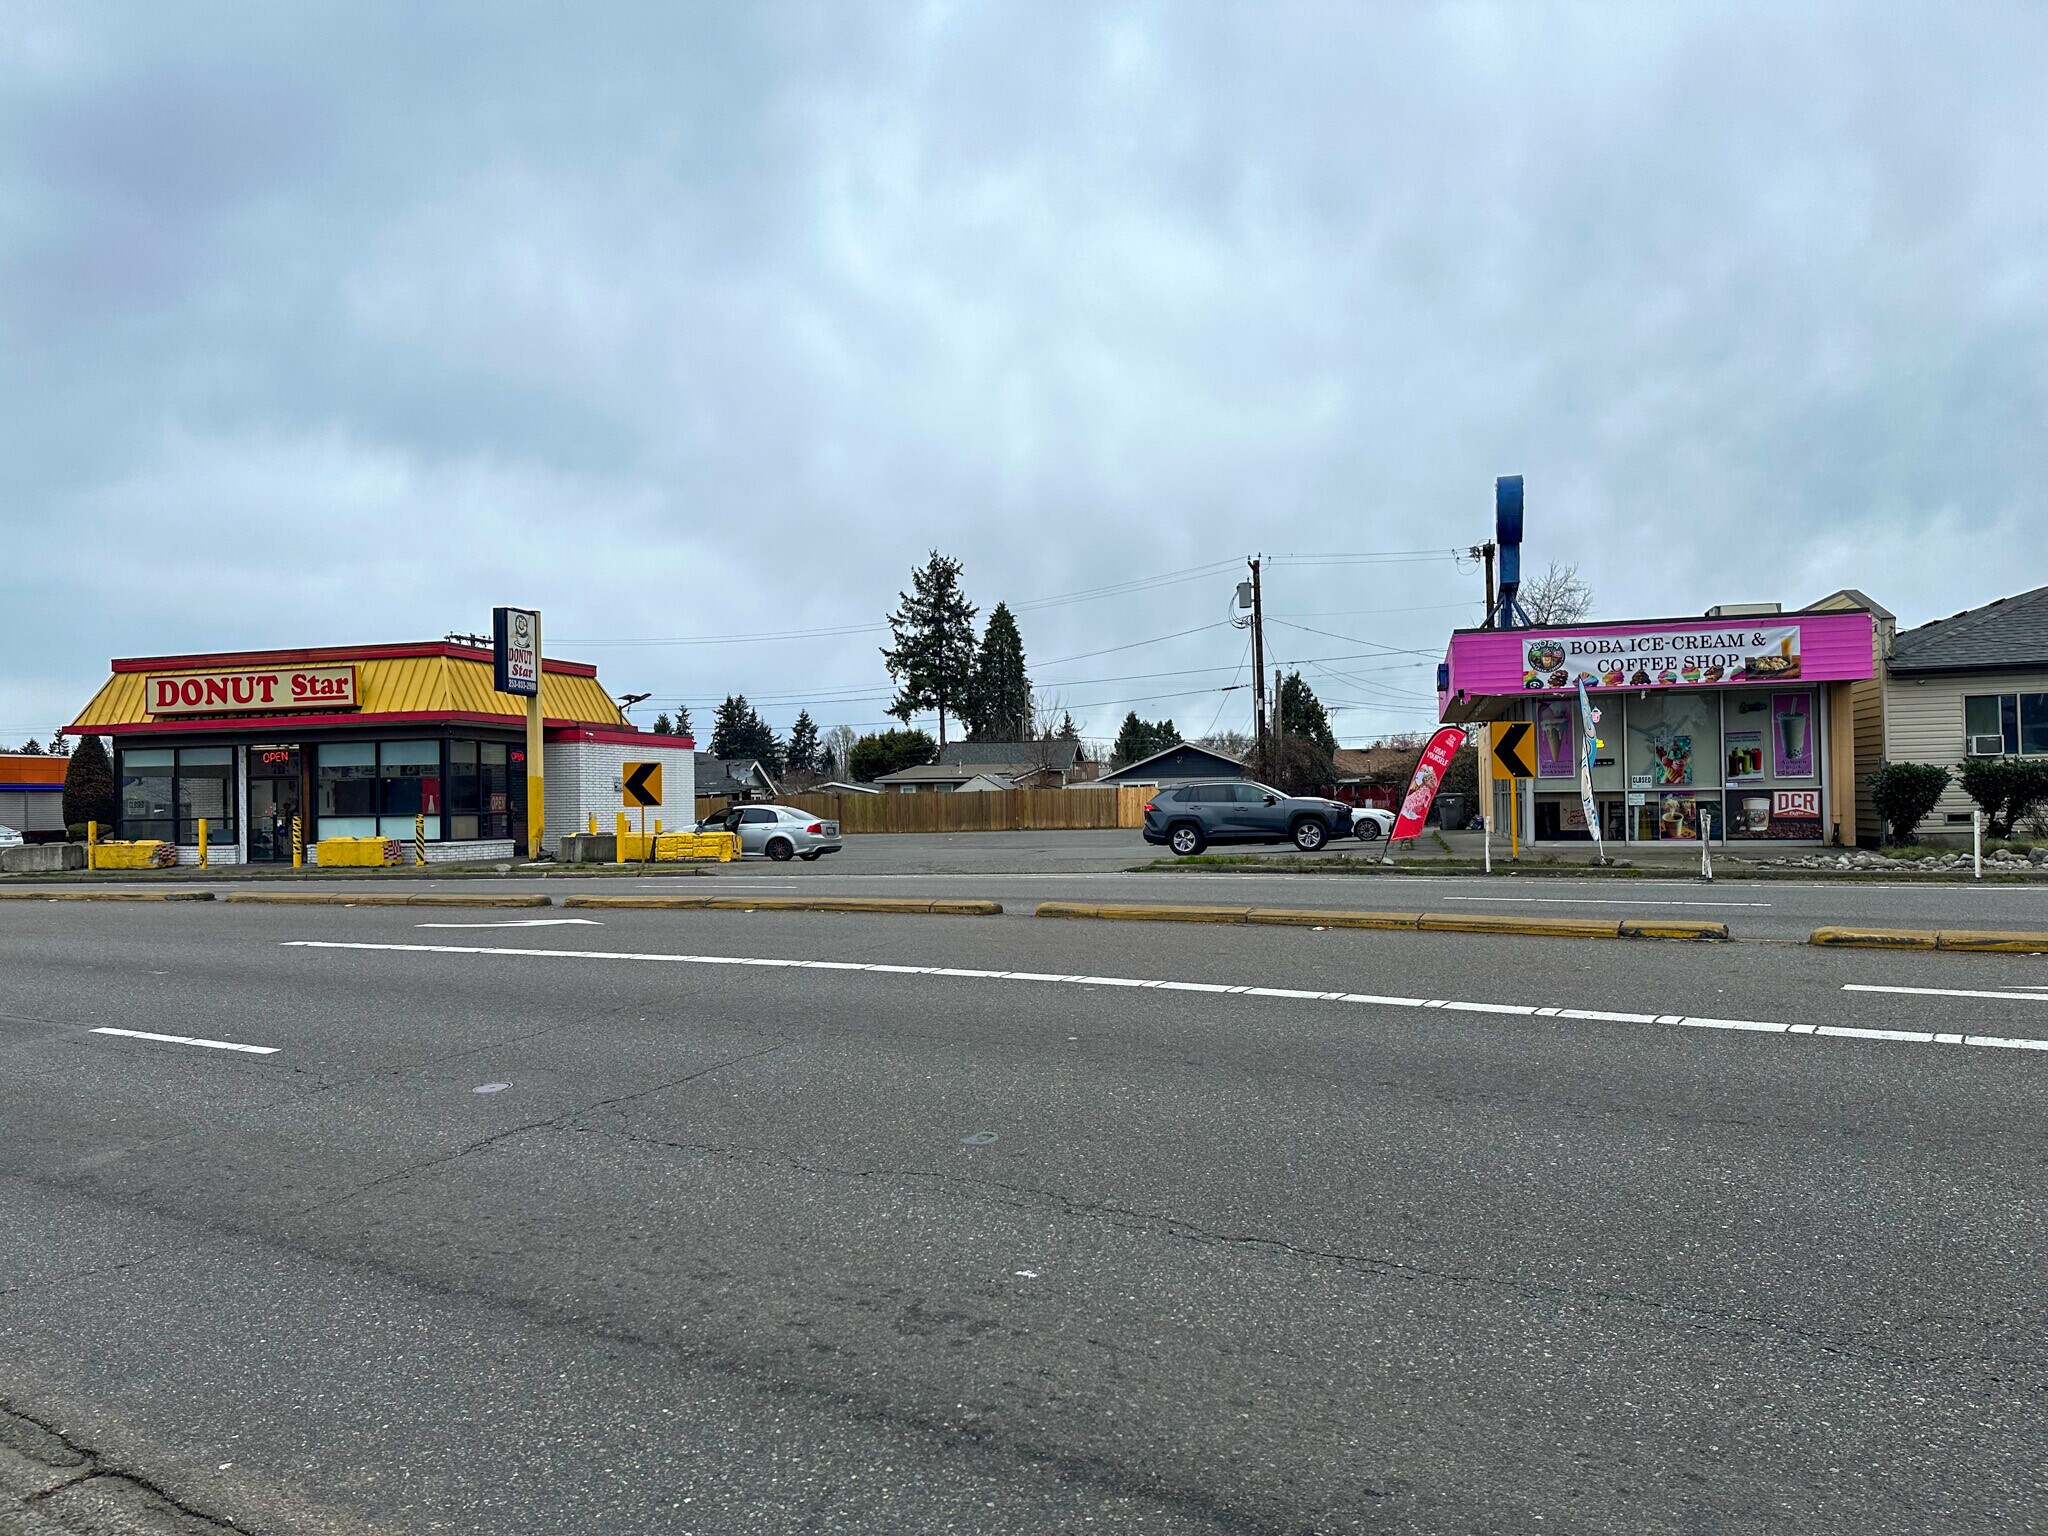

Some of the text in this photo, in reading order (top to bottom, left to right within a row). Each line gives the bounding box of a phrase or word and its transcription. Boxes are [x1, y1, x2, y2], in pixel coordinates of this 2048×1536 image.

[1533, 640, 1561, 650] BOBA
[1570, 632, 1767, 655] BOBA ICE-CREAM &
[508, 647, 533, 665] DONUT
[1597, 654, 1740, 673] COFFEE SHOP
[512, 664, 533, 678] Star
[156, 674, 349, 707] DONUT Star
[263, 751, 289, 763] OPEN
[1427, 750, 1449, 766] YOURSELF
[1433, 745, 1447, 758] TREAT
[1632, 776, 1652, 784] CLOSED
[1778, 793, 1814, 811] DCR
